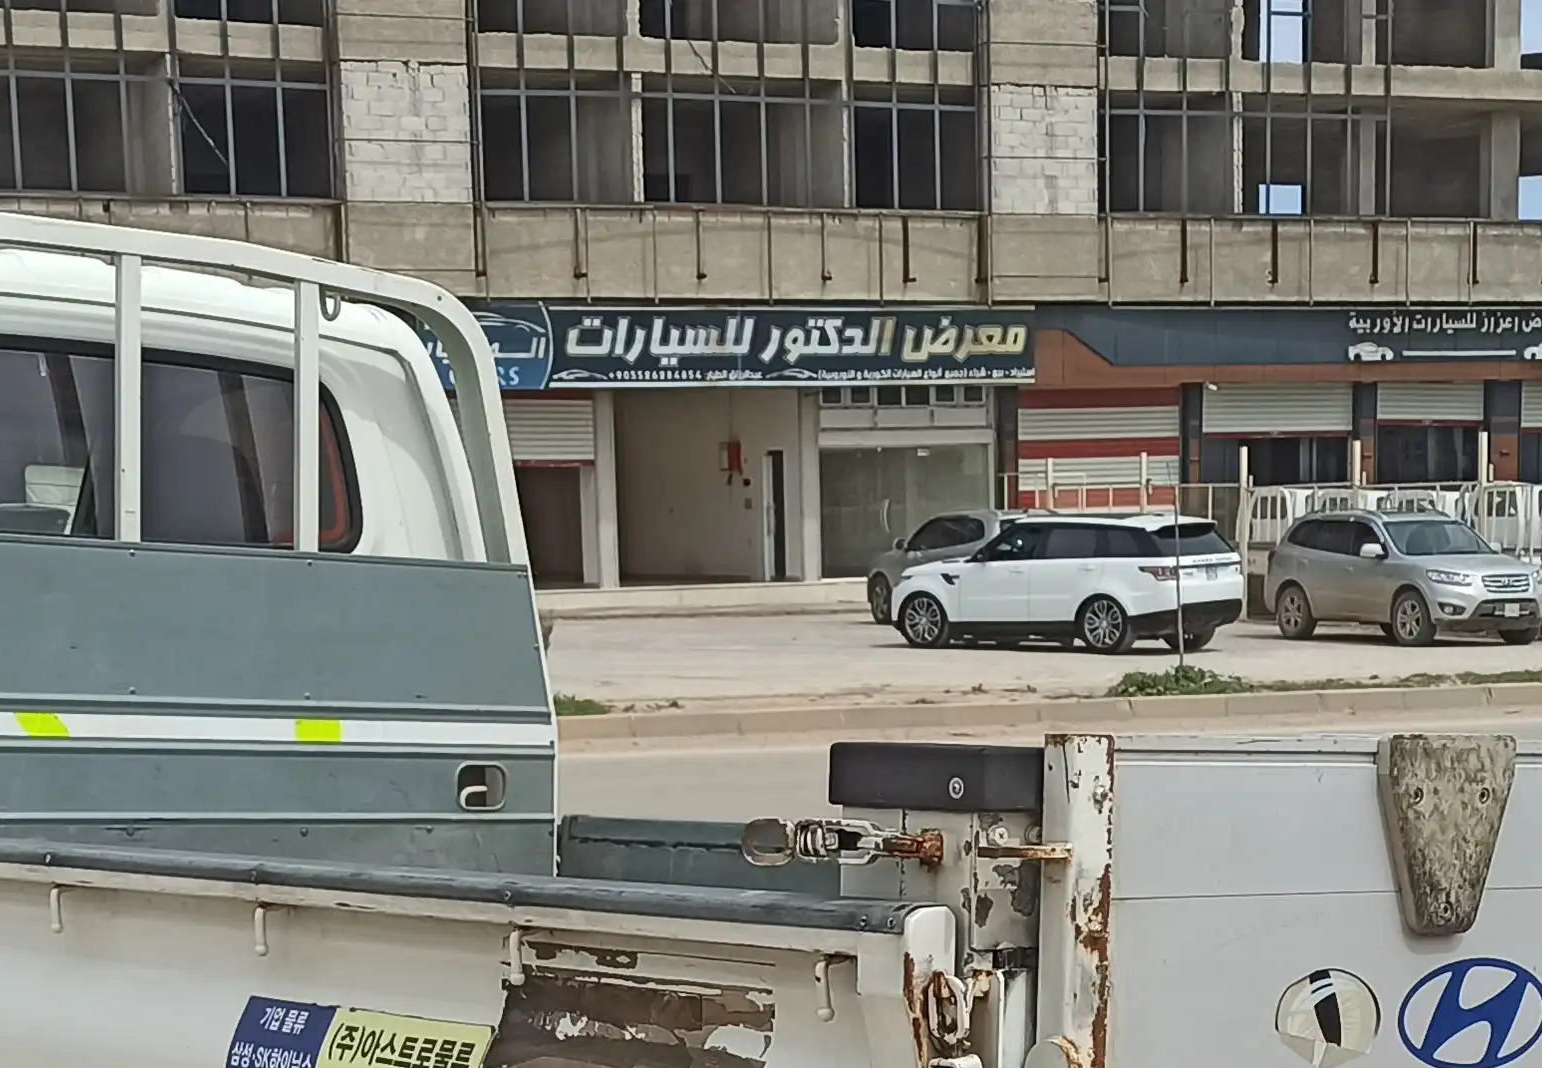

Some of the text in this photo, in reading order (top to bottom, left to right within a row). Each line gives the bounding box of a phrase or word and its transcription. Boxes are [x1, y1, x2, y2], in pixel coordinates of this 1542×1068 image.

[566, 316, 756, 367] للسيارات
[760, 316, 897, 365] الدكتور
[901, 316, 1027, 362] معرض
[1413, 312, 1476, 333] للسيارات
[260, 1006, 309, 1035] 기업 물류
